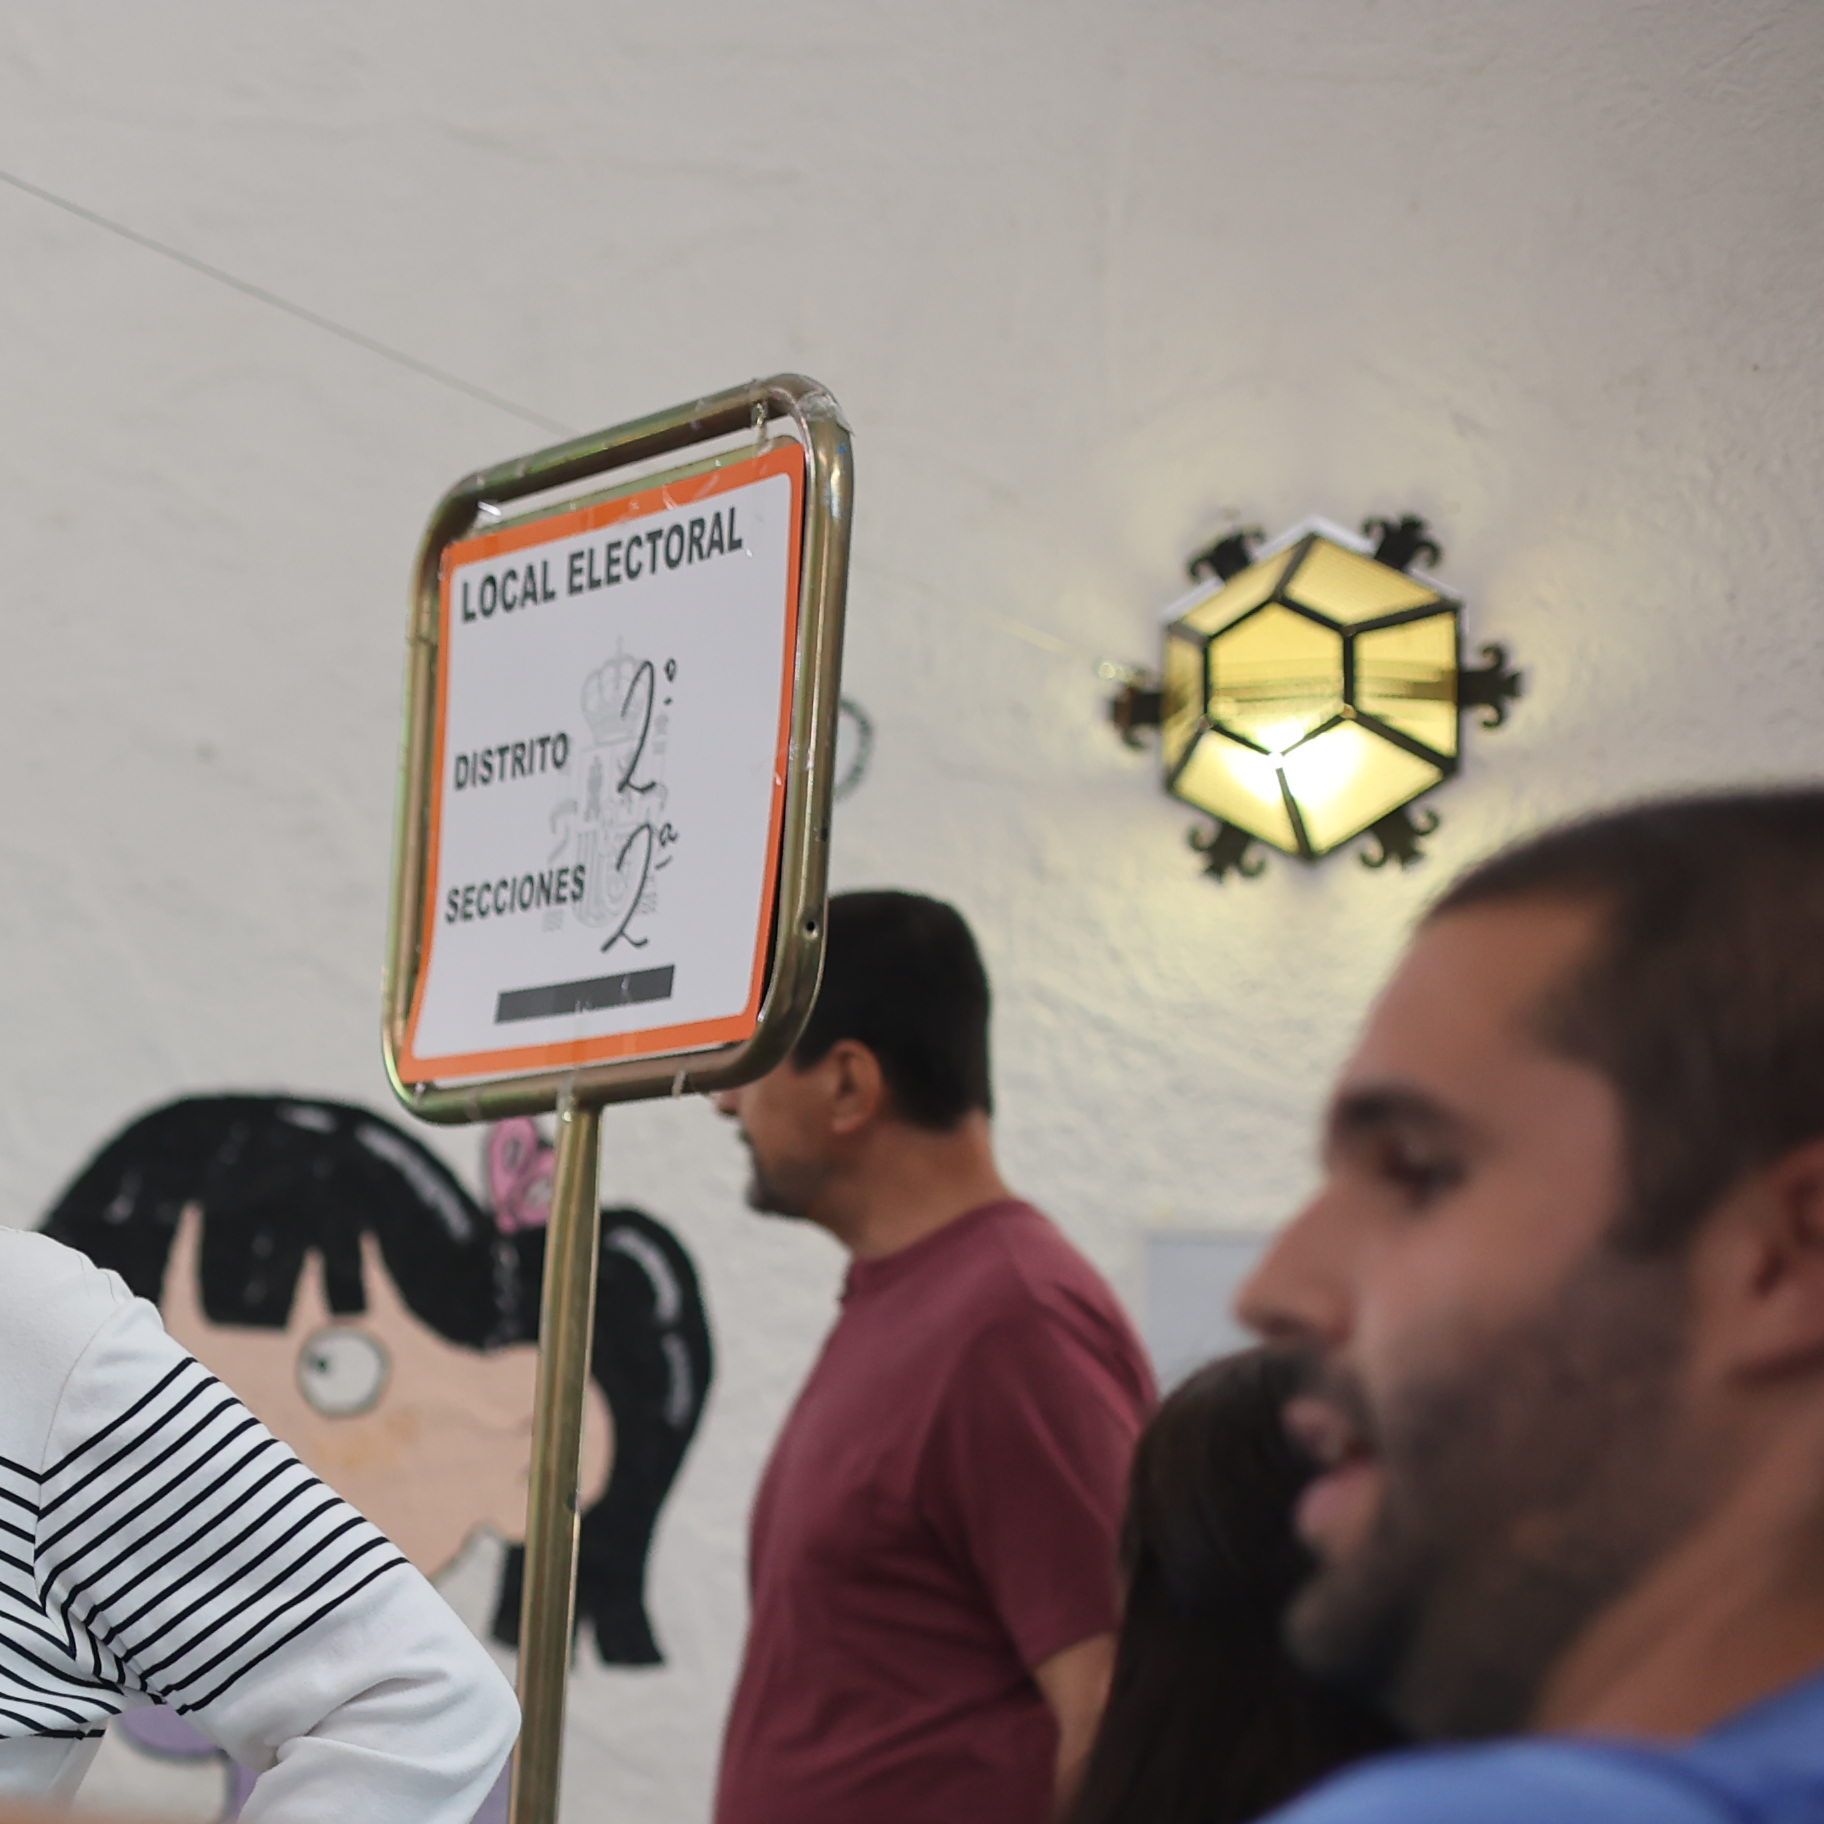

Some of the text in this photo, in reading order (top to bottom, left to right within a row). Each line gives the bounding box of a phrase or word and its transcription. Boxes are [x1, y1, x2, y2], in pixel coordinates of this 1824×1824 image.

[462, 506, 744, 623] LOCAL ELECTORAL
[454, 731, 570, 791] DISTRITO
[444, 864, 586, 925] SECCIONES
